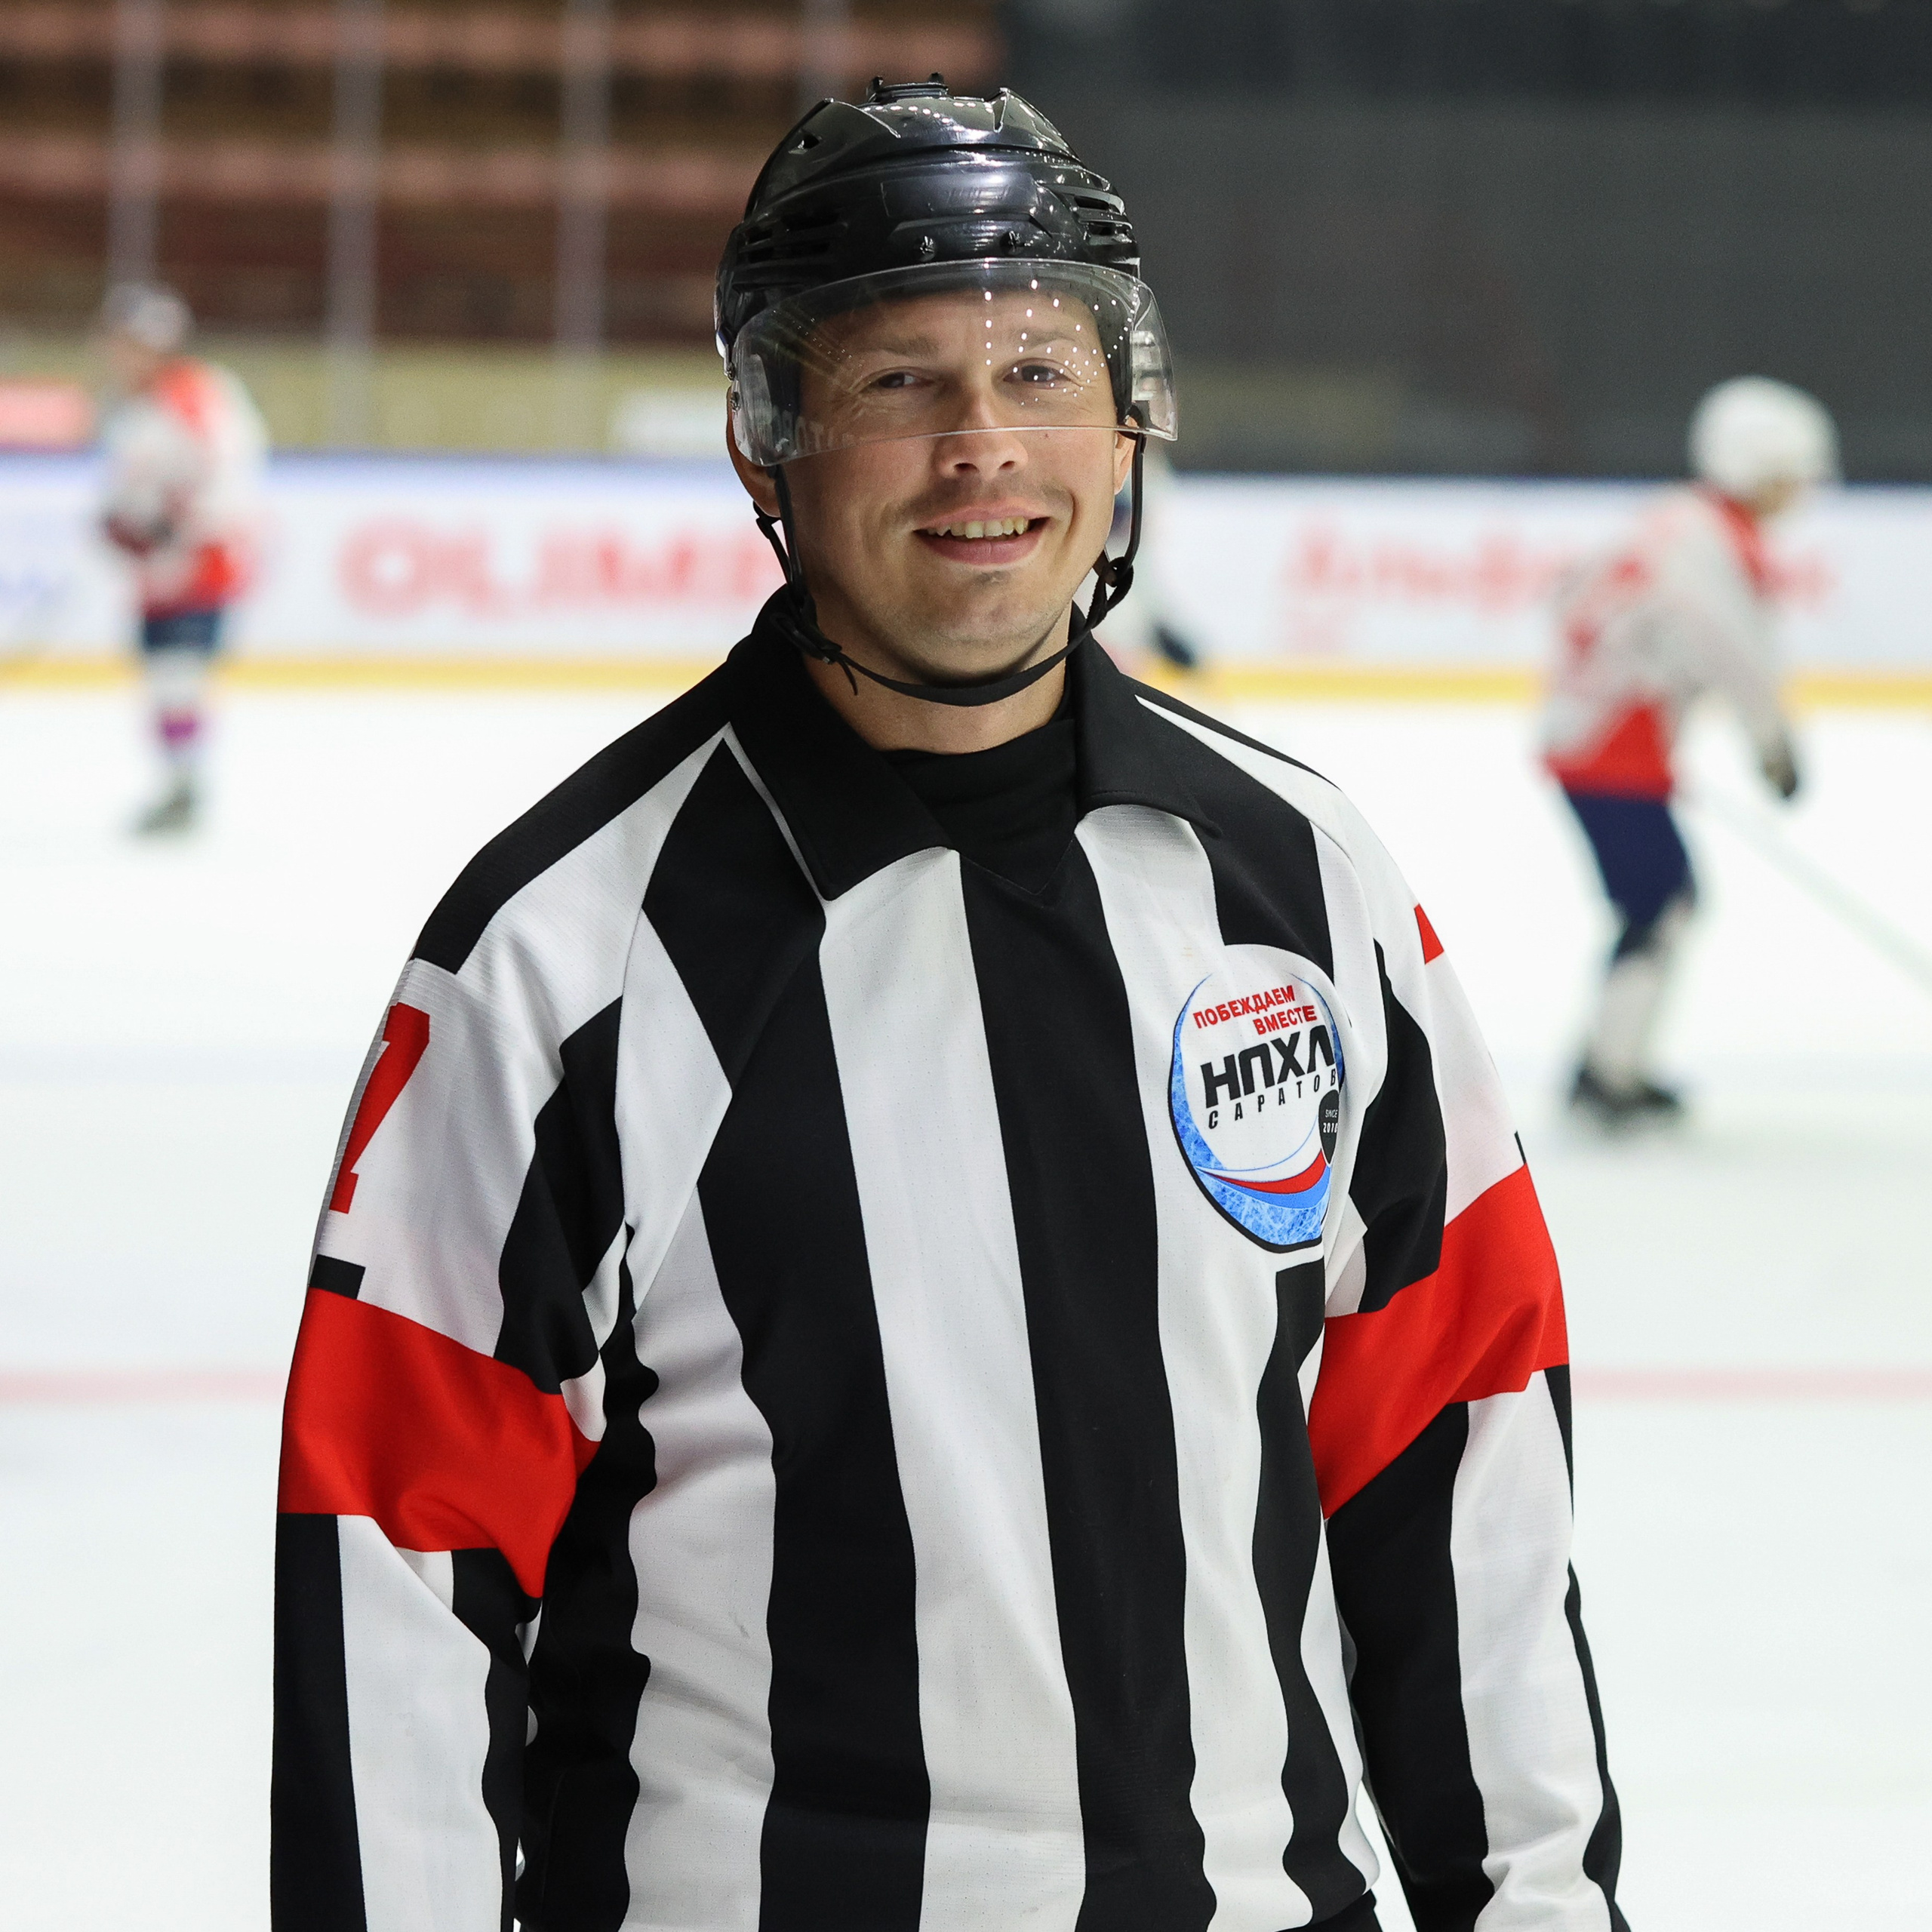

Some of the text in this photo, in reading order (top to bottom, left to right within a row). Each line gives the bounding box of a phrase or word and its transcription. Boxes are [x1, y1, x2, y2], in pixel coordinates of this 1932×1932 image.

[1193, 985, 1296, 1029] ПОБЕЖДАЕМ
[1253, 1005, 1318, 1035] ВМЕСТЕ
[1200, 1025, 1335, 1109] НПХЛ
[1208, 1069, 1336, 1129] САРАТОВ
[1324, 1109, 1338, 1118] SINCE
